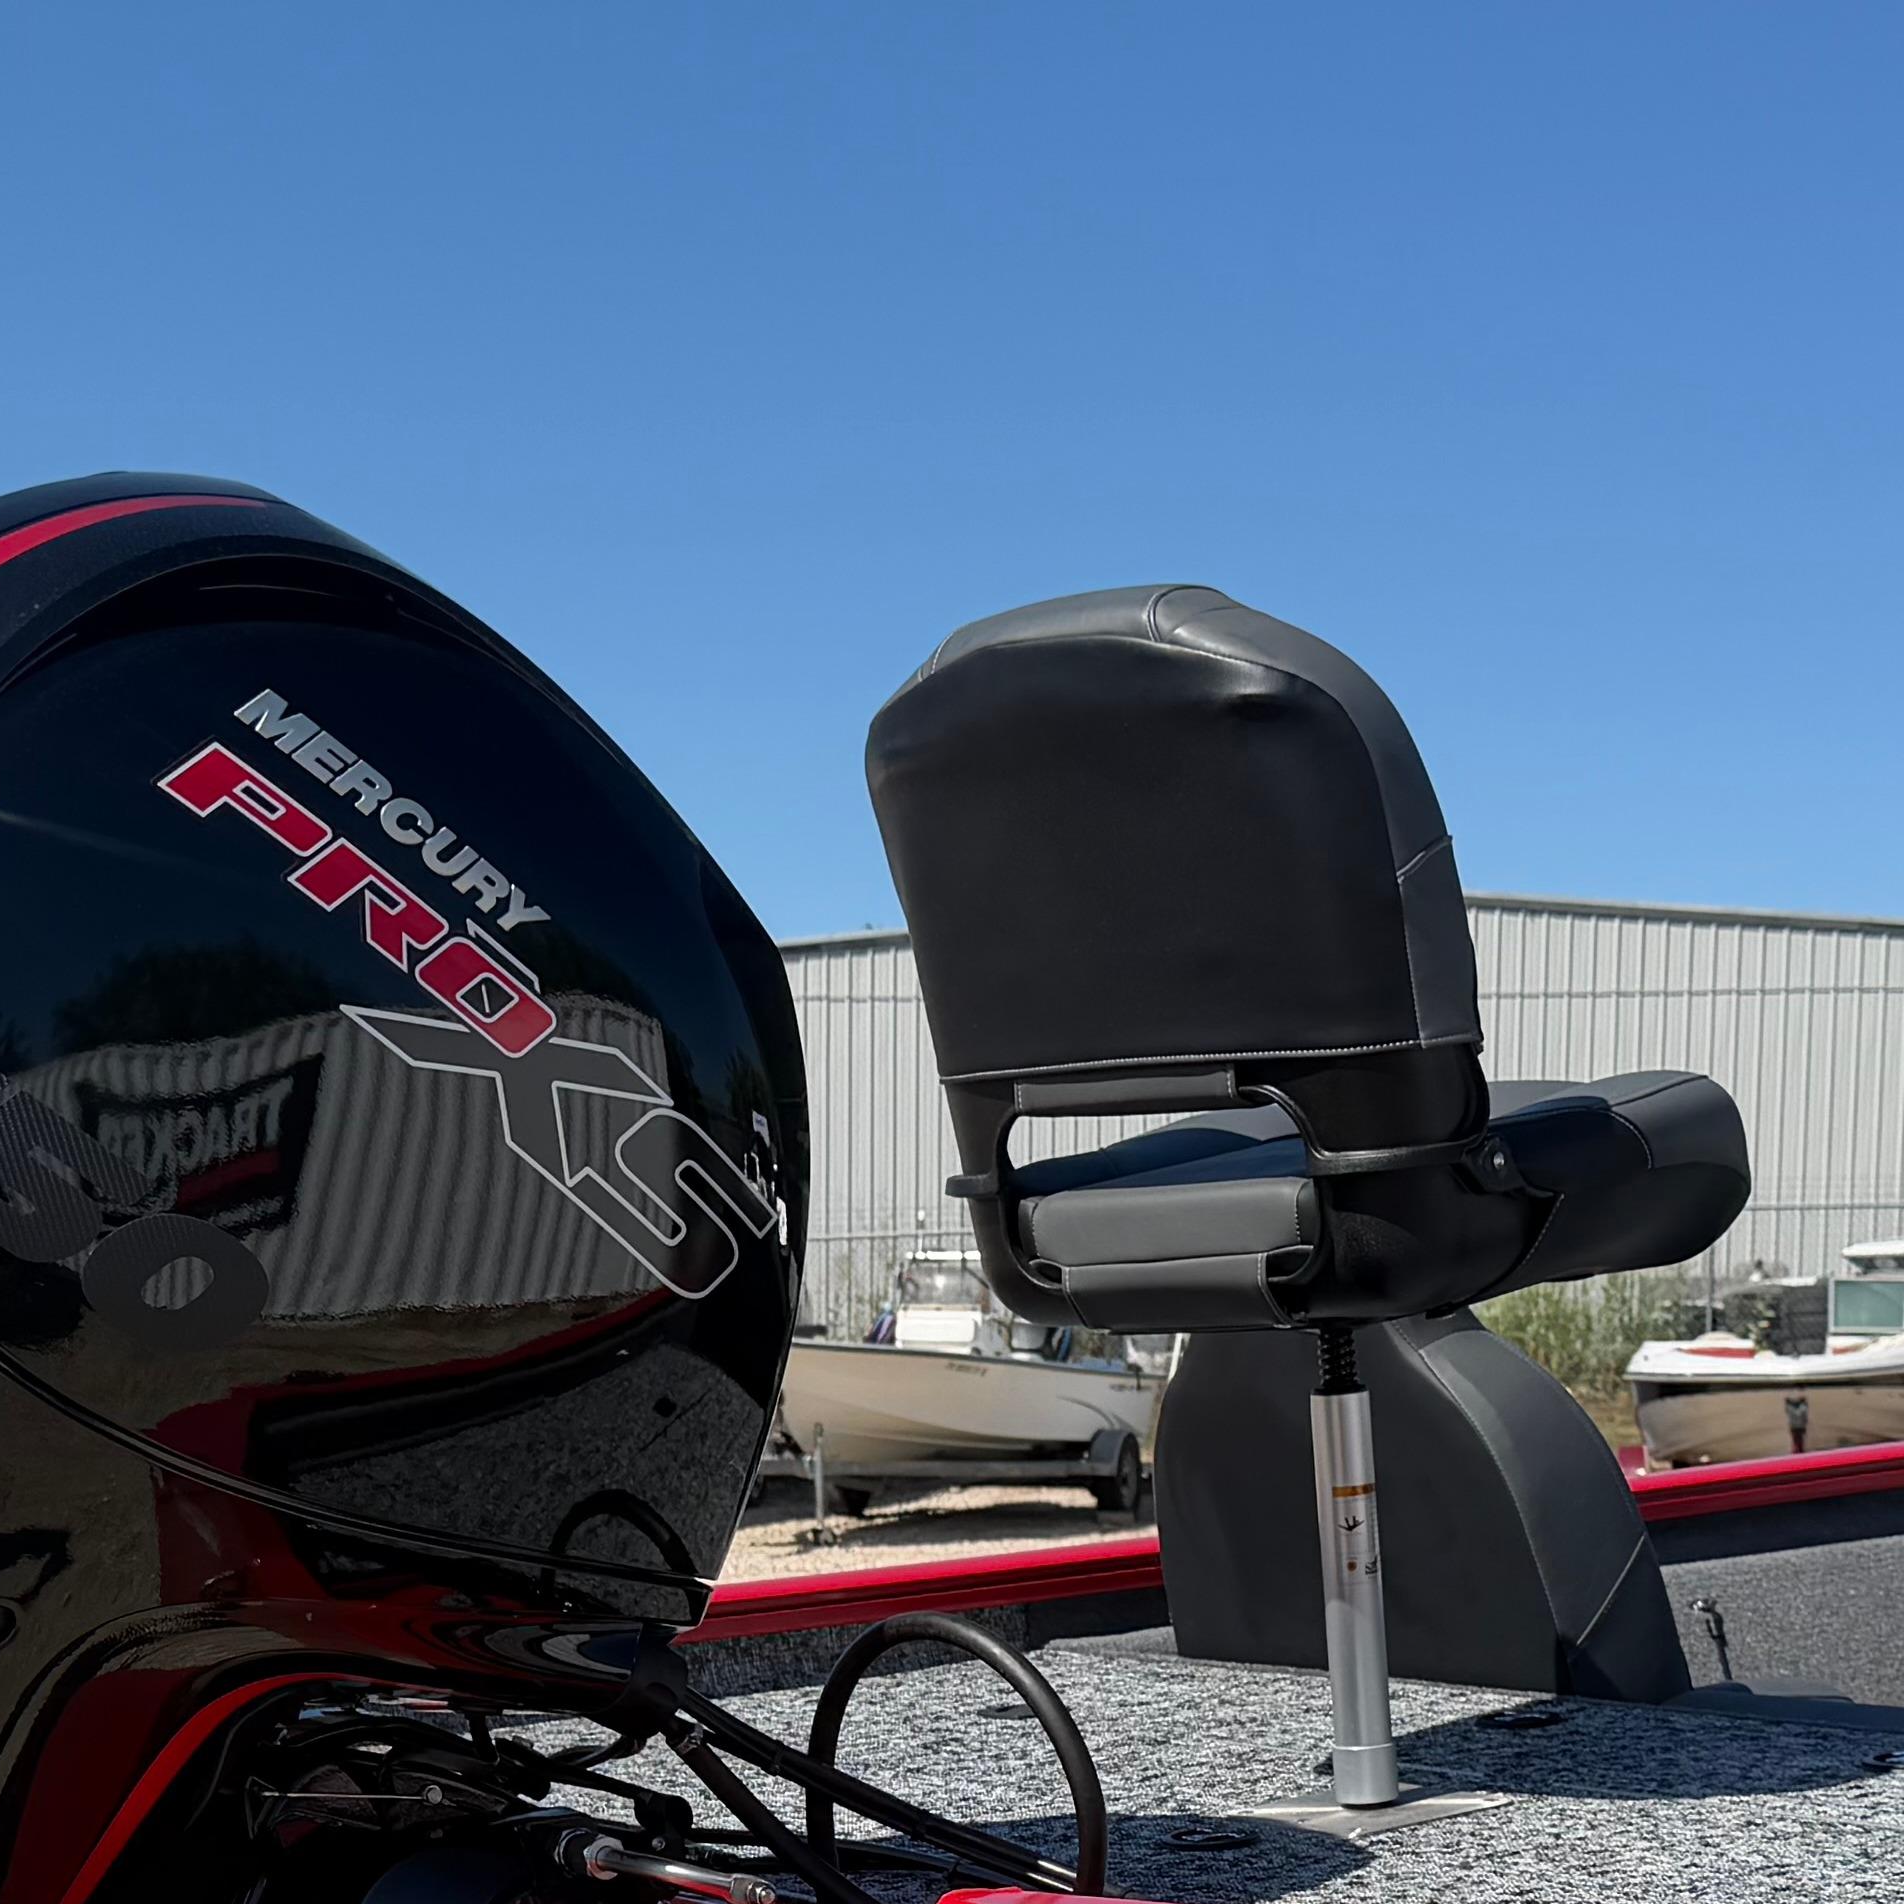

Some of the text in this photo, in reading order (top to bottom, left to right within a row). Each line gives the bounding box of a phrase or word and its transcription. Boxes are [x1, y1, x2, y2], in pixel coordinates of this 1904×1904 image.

[155, 739, 558, 1059] PRO
[233, 688, 551, 932] MERCURY
[339, 917, 780, 1300] XS
